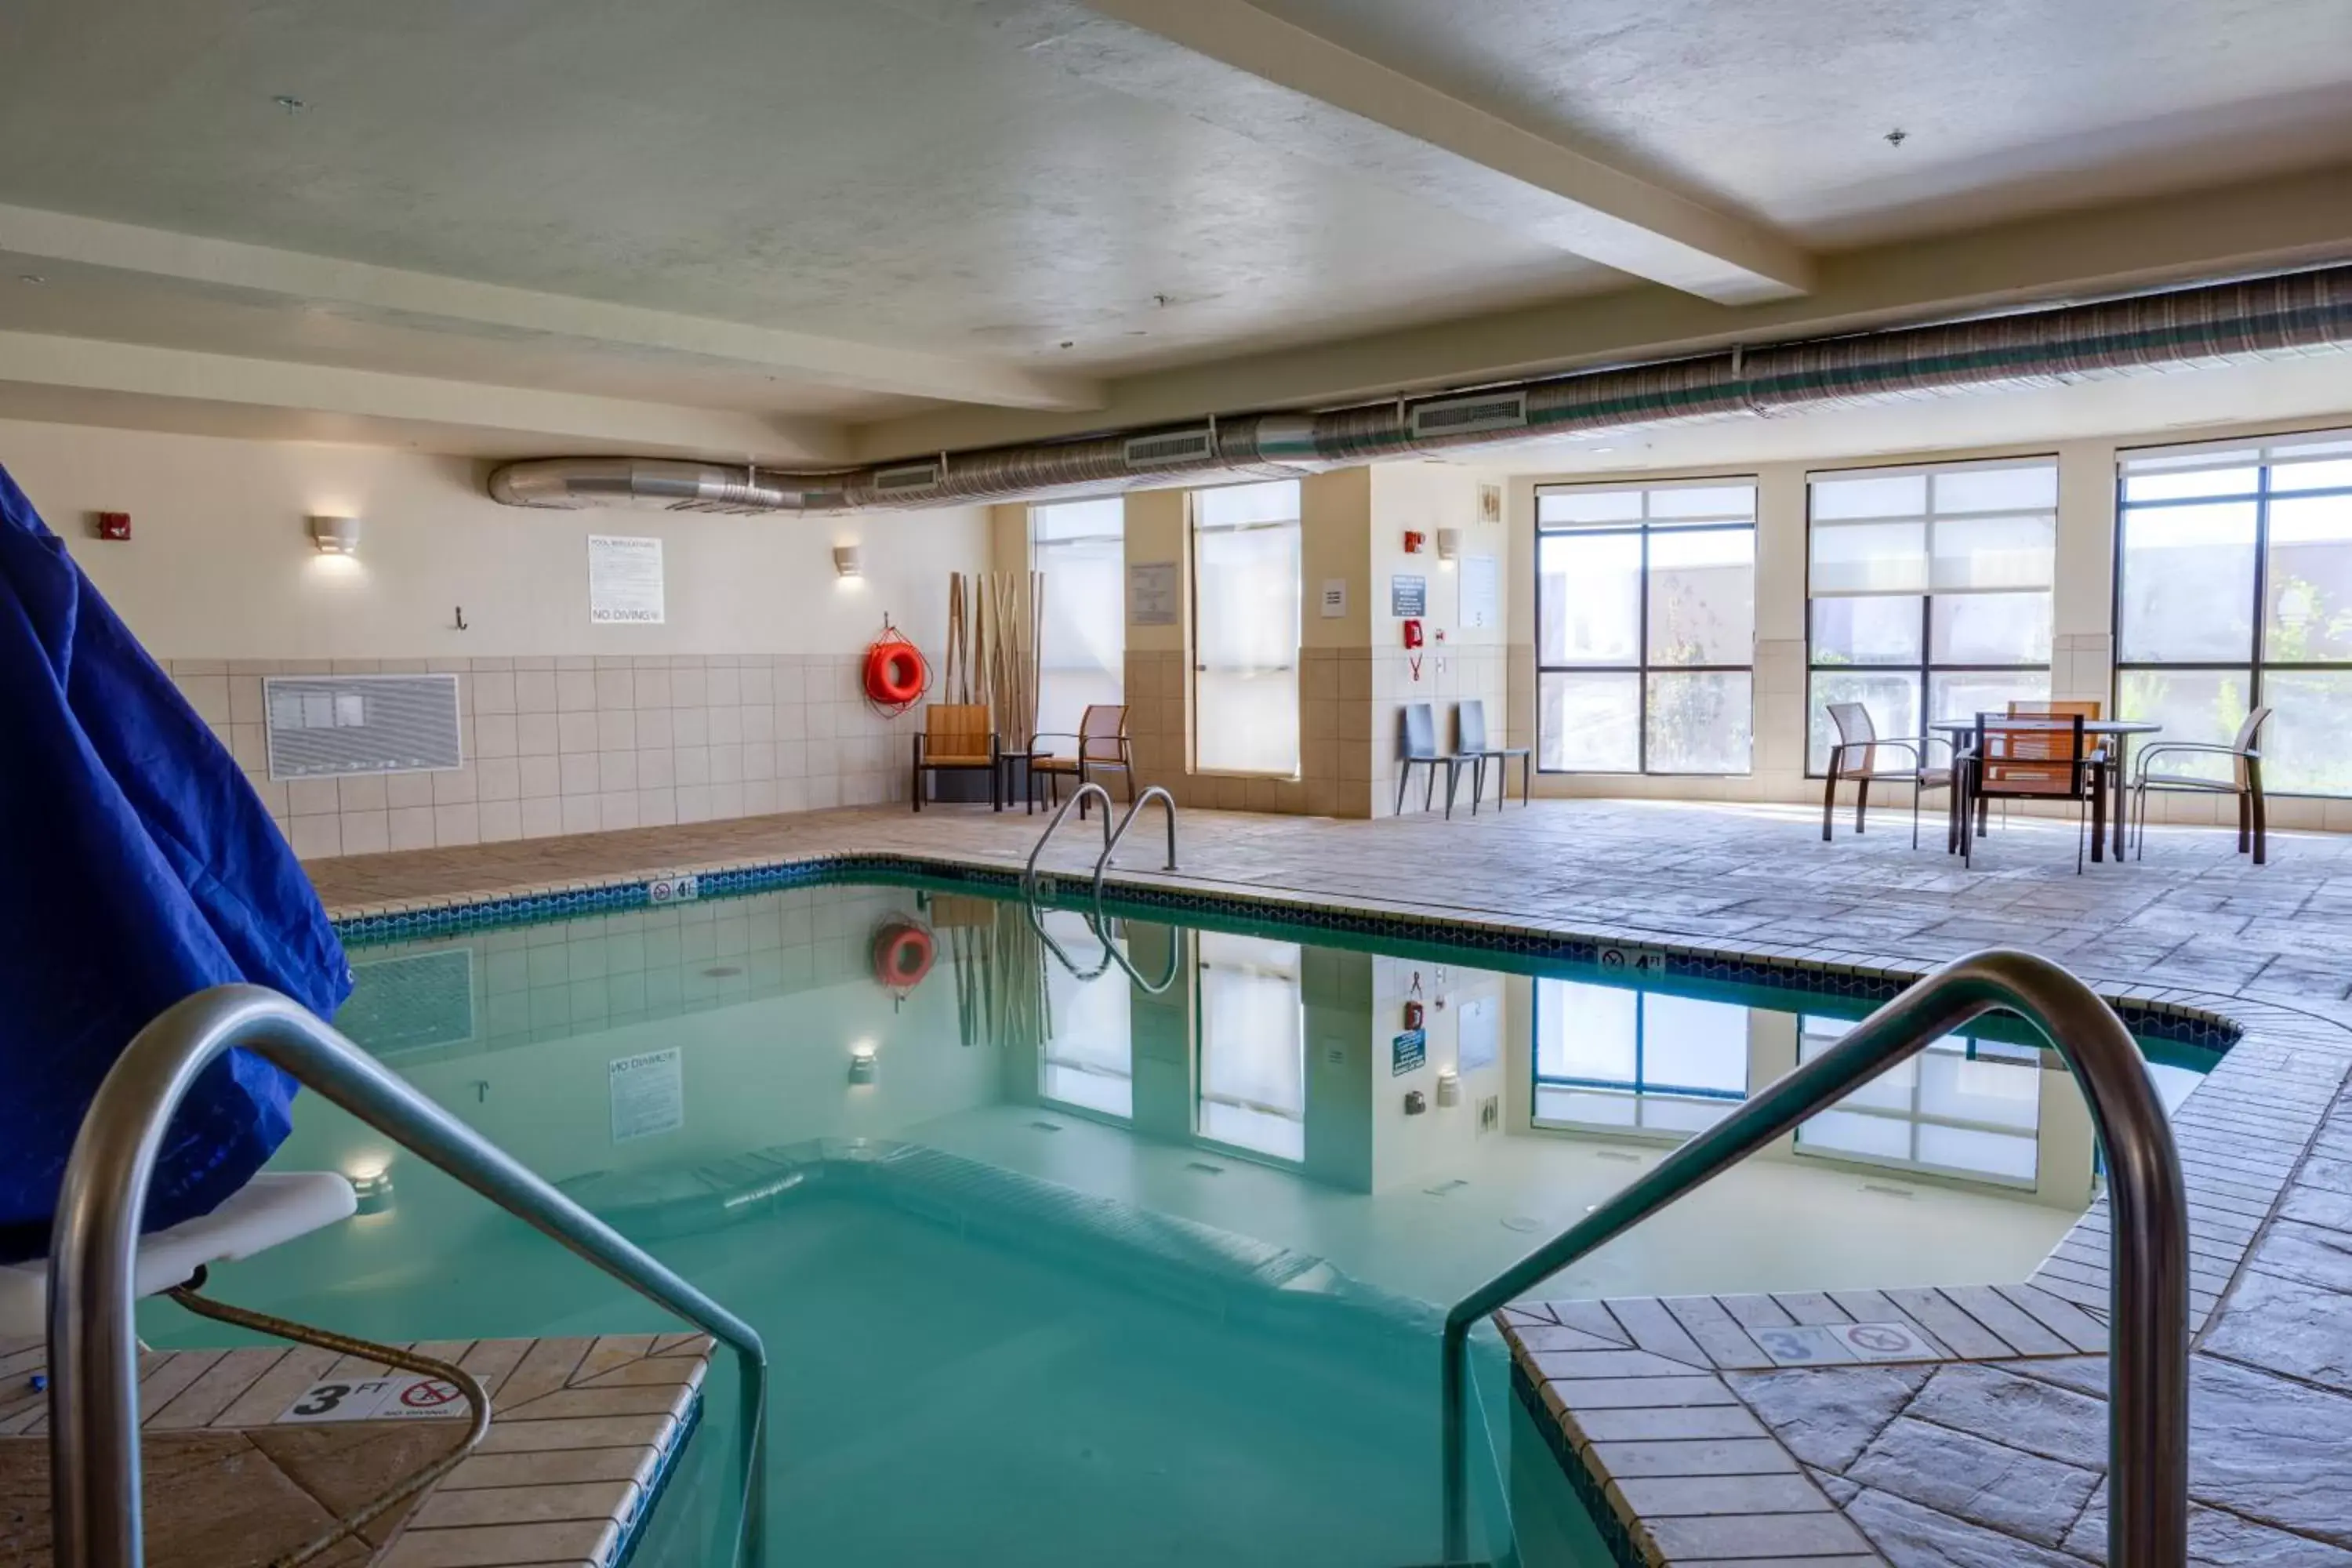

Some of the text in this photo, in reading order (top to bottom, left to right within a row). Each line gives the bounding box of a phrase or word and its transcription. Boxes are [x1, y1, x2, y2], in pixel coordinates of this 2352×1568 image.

[593, 610, 650, 620] NO DIVING
[1761, 1332, 1813, 1359] 3
[292, 1382, 389, 1416] 3 FT
